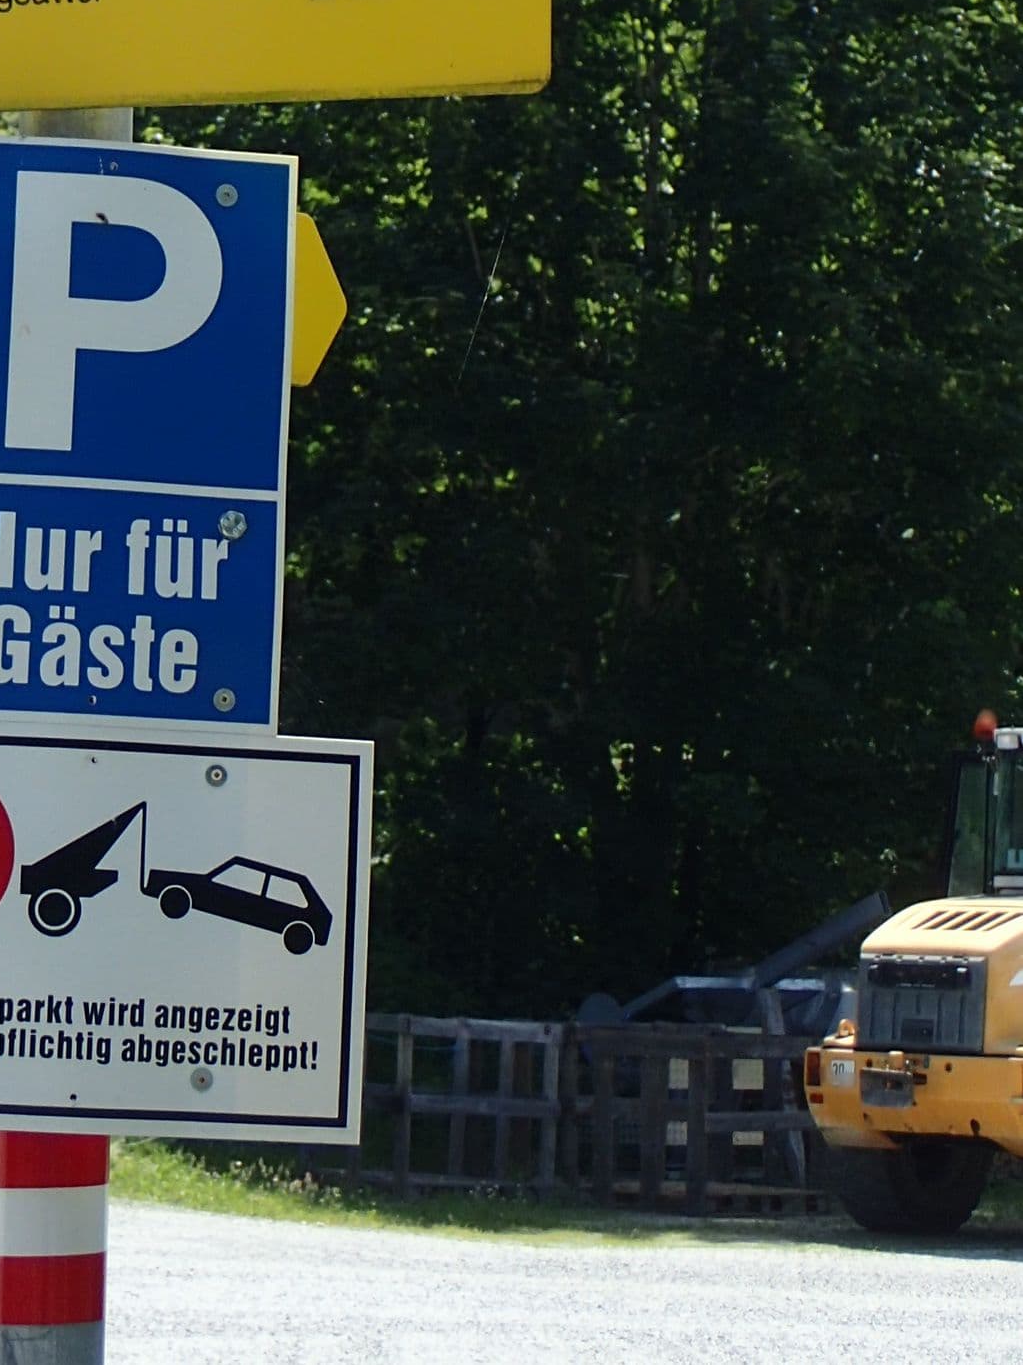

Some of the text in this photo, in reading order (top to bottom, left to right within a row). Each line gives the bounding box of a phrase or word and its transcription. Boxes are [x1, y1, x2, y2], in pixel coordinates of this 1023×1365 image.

[4, 170, 224, 452] P
[126, 518, 228, 601] für
[83, 996, 146, 1028] wird
[154, 1003, 291, 1036] angezeigt
[121, 1033, 318, 1072] abgeschleppt!
